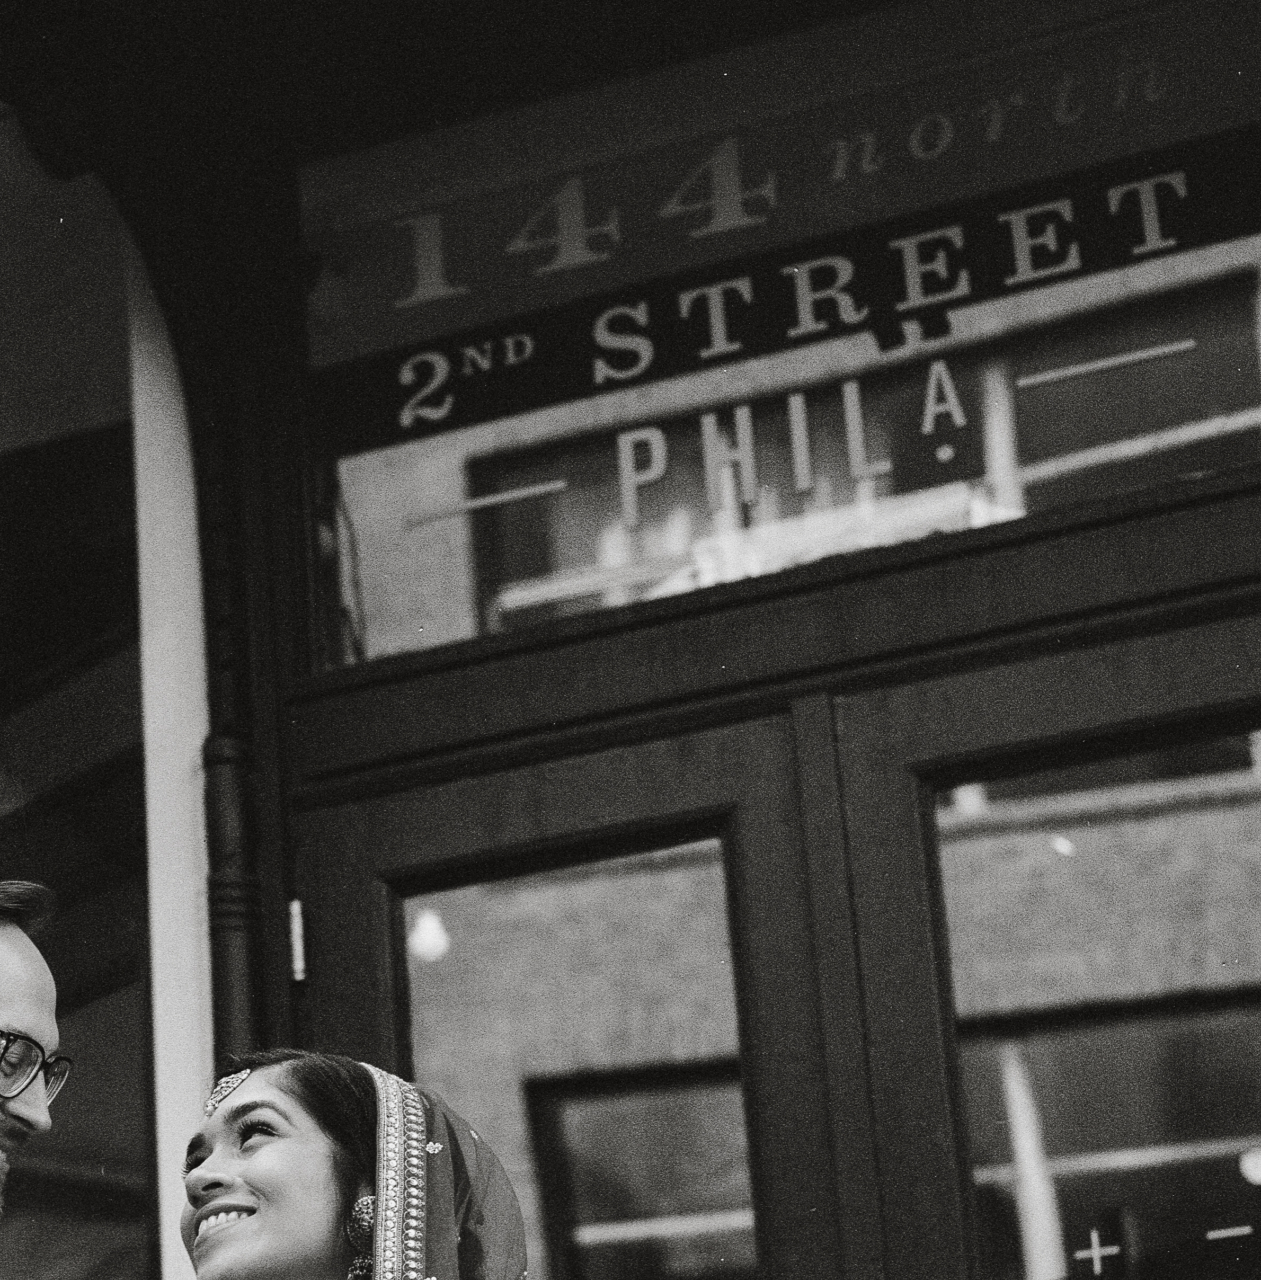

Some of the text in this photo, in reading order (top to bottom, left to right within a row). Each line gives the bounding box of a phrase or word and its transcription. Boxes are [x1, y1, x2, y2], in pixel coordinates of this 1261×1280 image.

[394, 138, 777, 310] 144
[397, 172, 1191, 428] 2ND STREET
